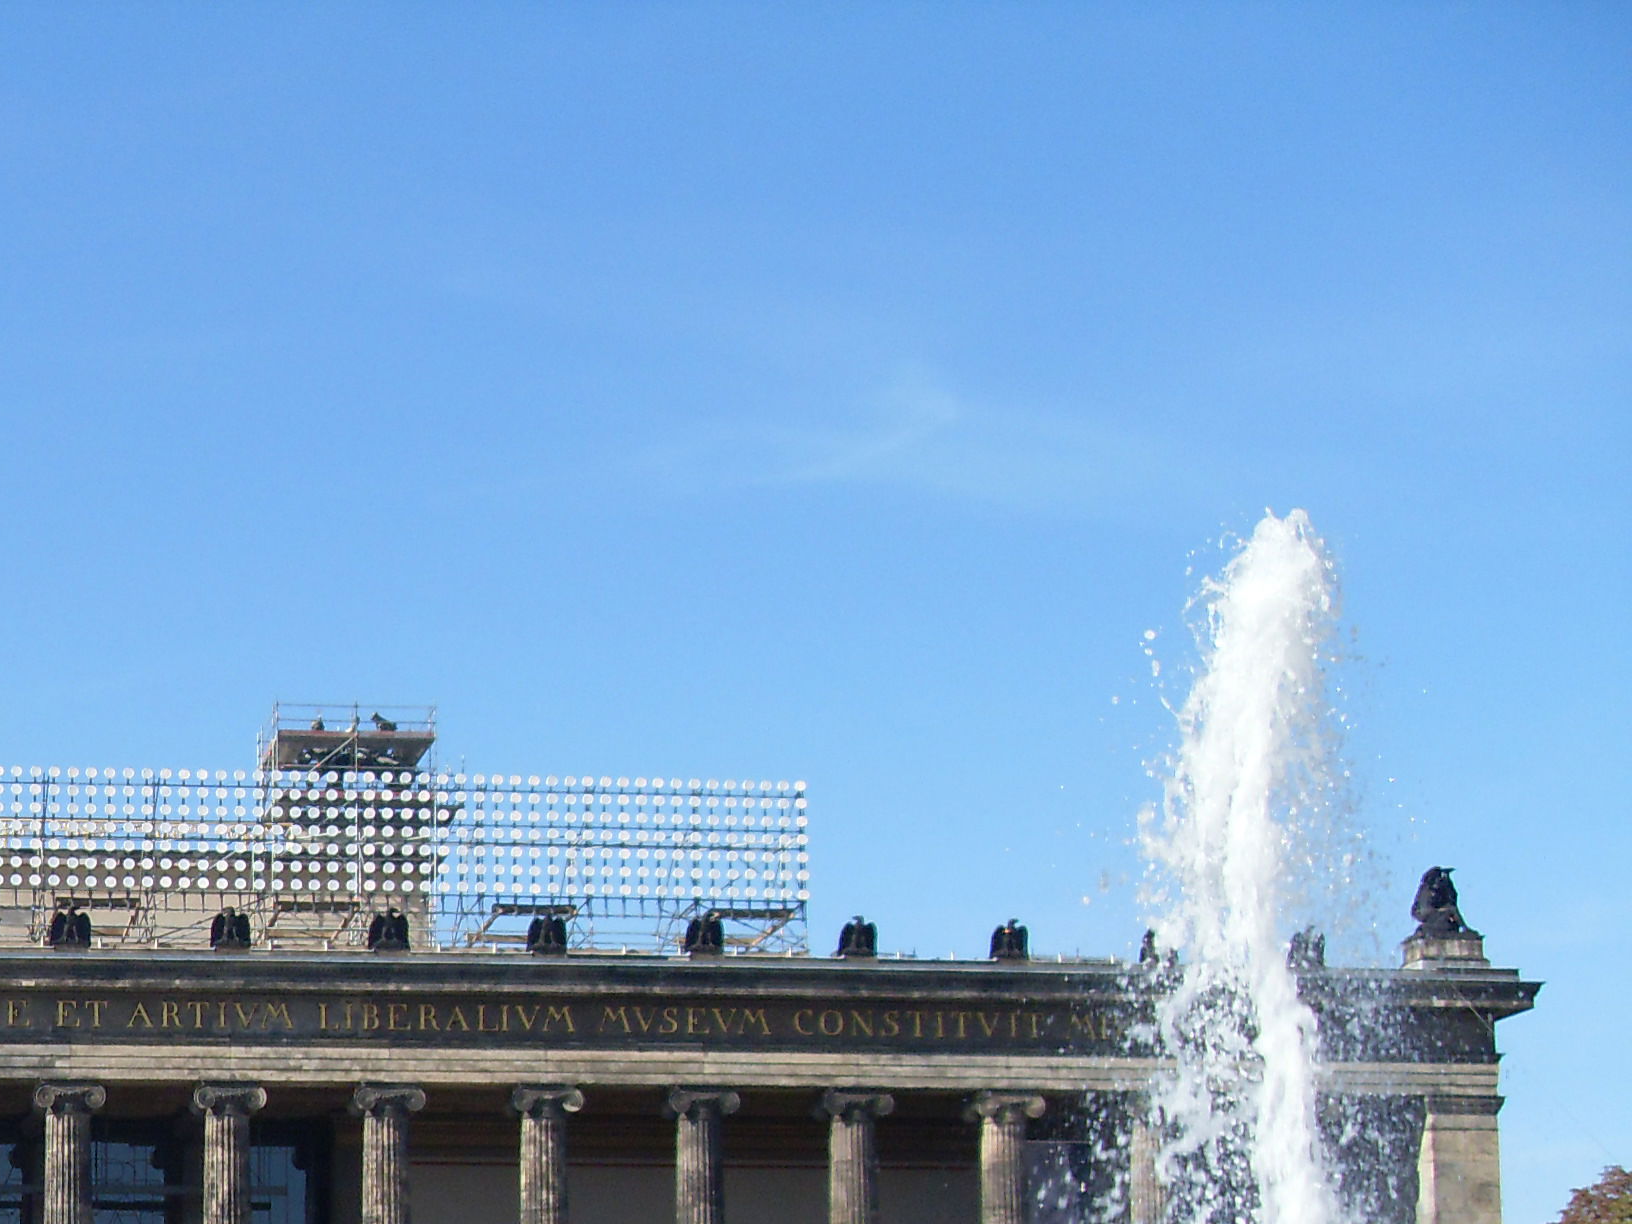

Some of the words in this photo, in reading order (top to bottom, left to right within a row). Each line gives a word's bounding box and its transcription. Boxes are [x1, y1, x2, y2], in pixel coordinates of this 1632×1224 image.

[57, 999, 109, 1028] ET
[127, 1000, 293, 1029] ARTIVM
[319, 1001, 576, 1034] LIBERALIVM
[601, 1006, 773, 1035] MVSEVM
[794, 1009, 1044, 1038] CONSTITVIT
